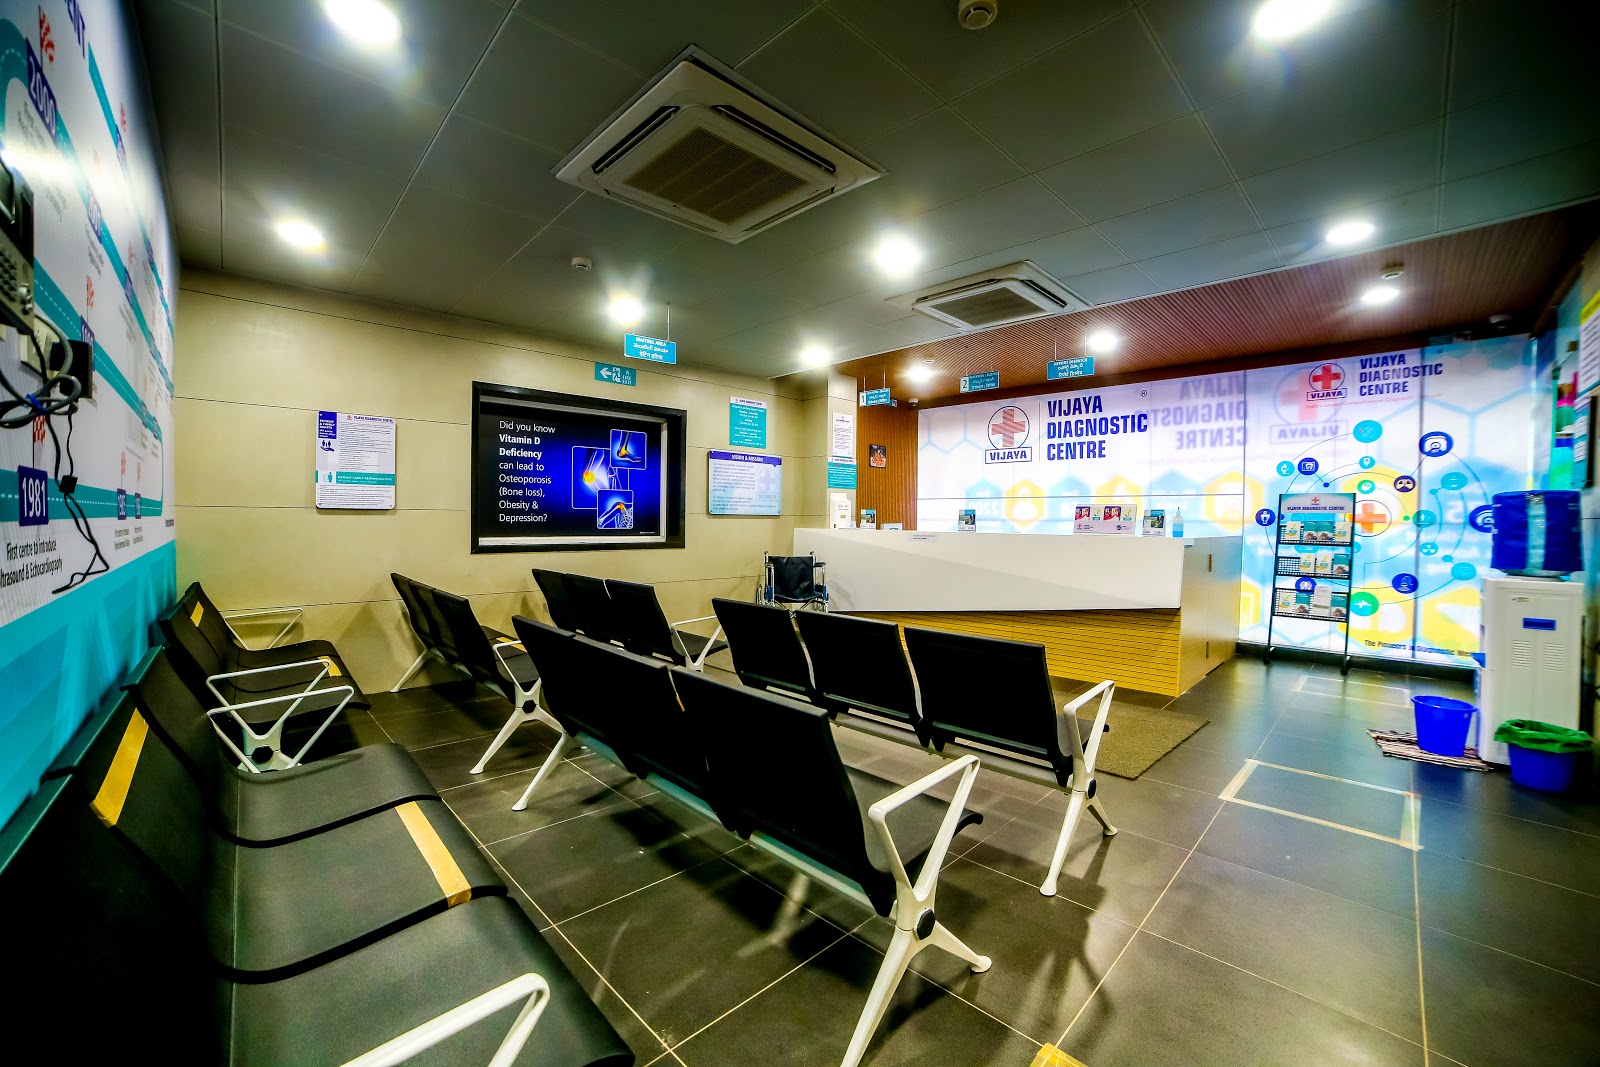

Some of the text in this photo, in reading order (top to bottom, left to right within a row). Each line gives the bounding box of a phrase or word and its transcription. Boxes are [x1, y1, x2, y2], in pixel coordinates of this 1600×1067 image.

[29, 55, 56, 136] 2000
[636, 337, 654, 345] WAITING
[1360, 353, 1406, 370] VIJAYA
[1359, 363, 1443, 383] DIAGNOSTIC
[963, 380, 967, 388] 2
[1359, 381, 1409, 396] CENTRE
[1048, 395, 1103, 417] VIJAYA
[499, 420, 556, 433] Did you know
[1047, 413, 1148, 439] DIAGNOSTIC
[499, 434, 541, 445] Vitamin D
[499, 447, 542, 460] Deficiency
[990, 450, 1027, 461] VIJAYA
[1047, 440, 1106, 461] CENTRE
[516, 461, 534, 470] lead
[536, 463, 544, 471] to
[499, 473, 551, 485] Osteoporosis
[22, 477, 46, 517] 1981
[499, 486, 545, 497] (Bone loss),
[499, 500, 539, 511] Obesity &
[499, 513, 548, 524] Depression?
[7, 537, 56, 560] First centre to introduce
[30, 554, 62, 578] Echocardiography
[1364, 639, 1376, 647] The
